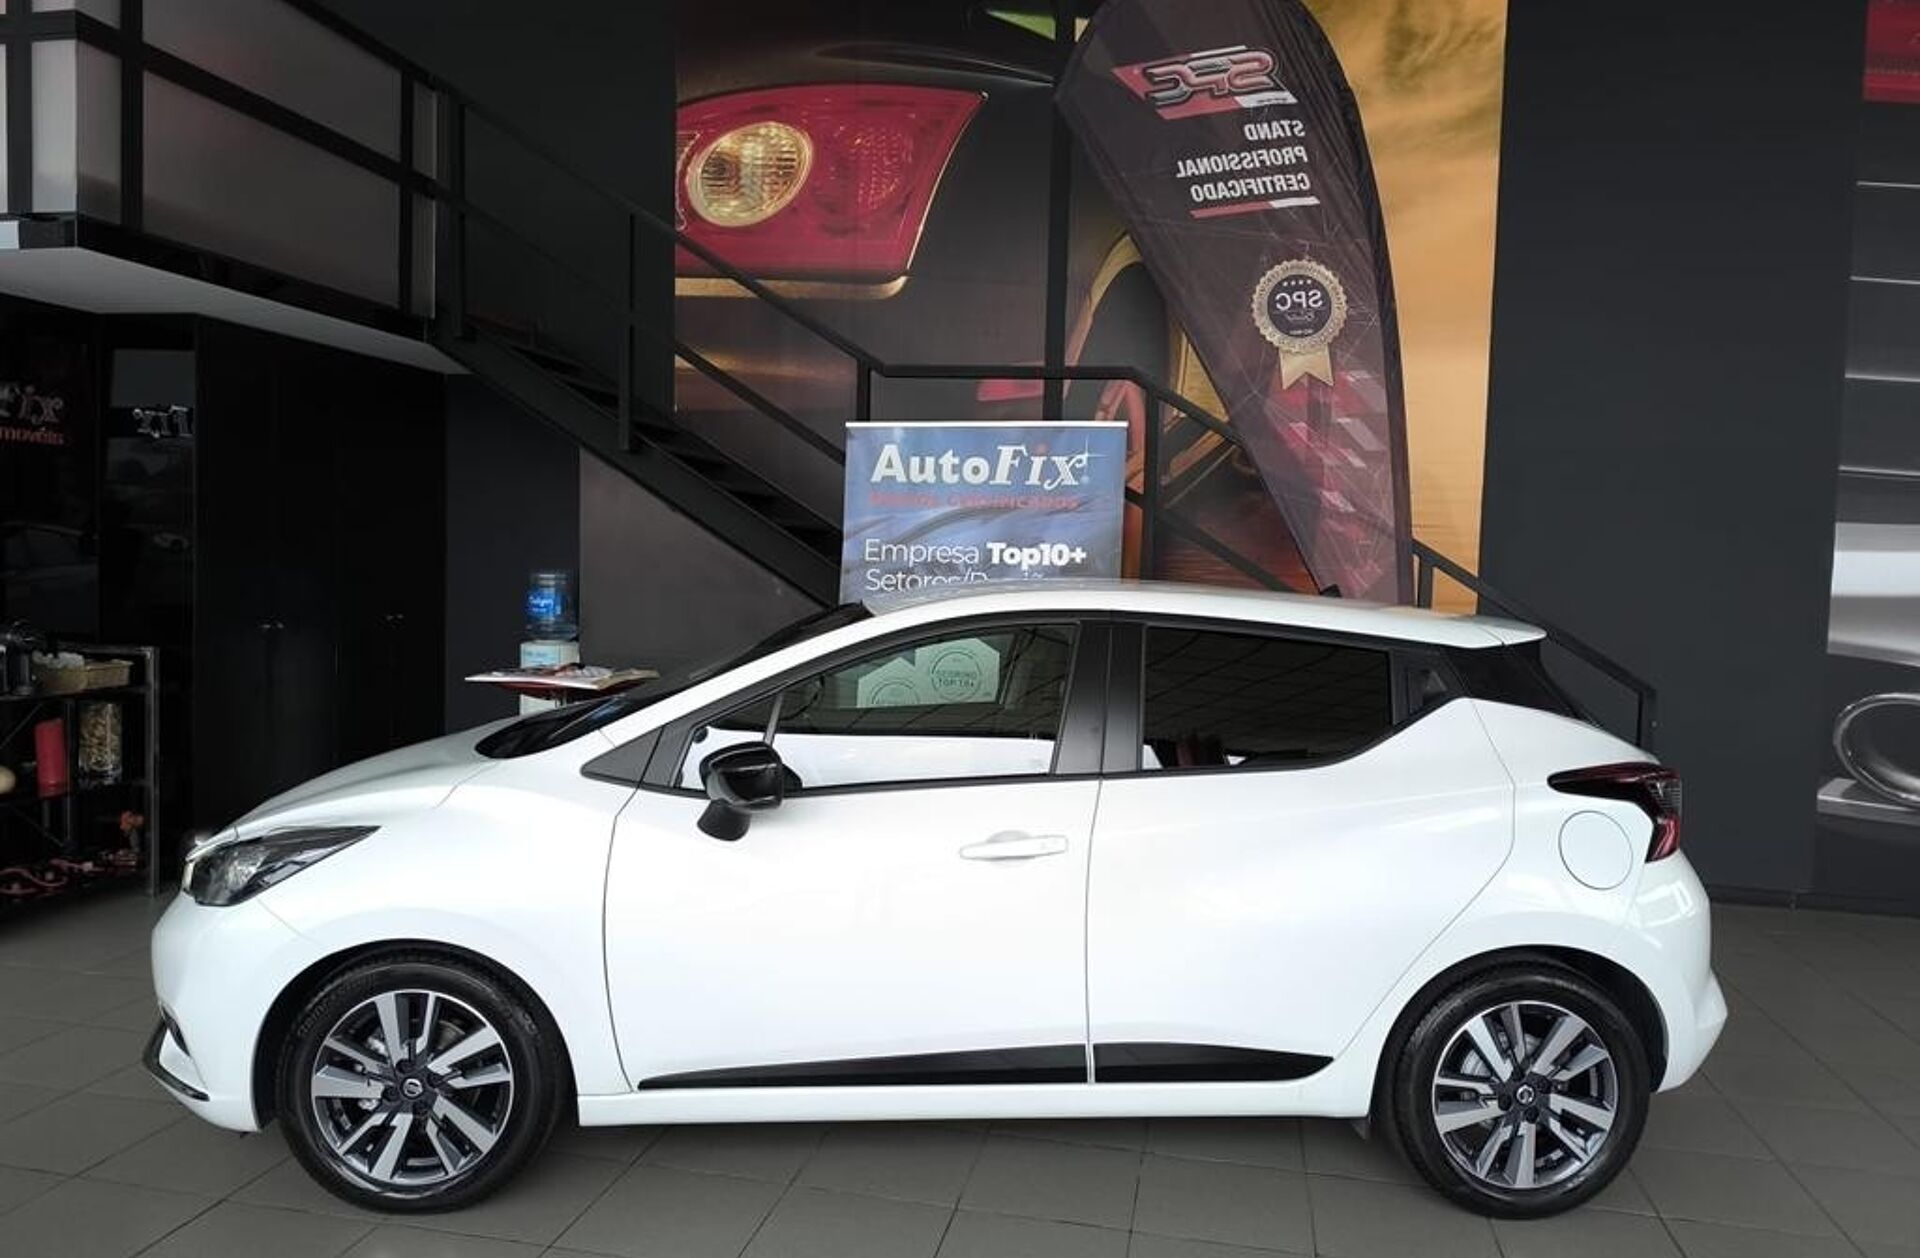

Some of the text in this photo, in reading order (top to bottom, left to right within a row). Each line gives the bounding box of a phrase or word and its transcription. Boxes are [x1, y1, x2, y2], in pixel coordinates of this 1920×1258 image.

[871, 444, 1088, 490] AutoFix
[865, 539, 1087, 570] Empresa Top10+
